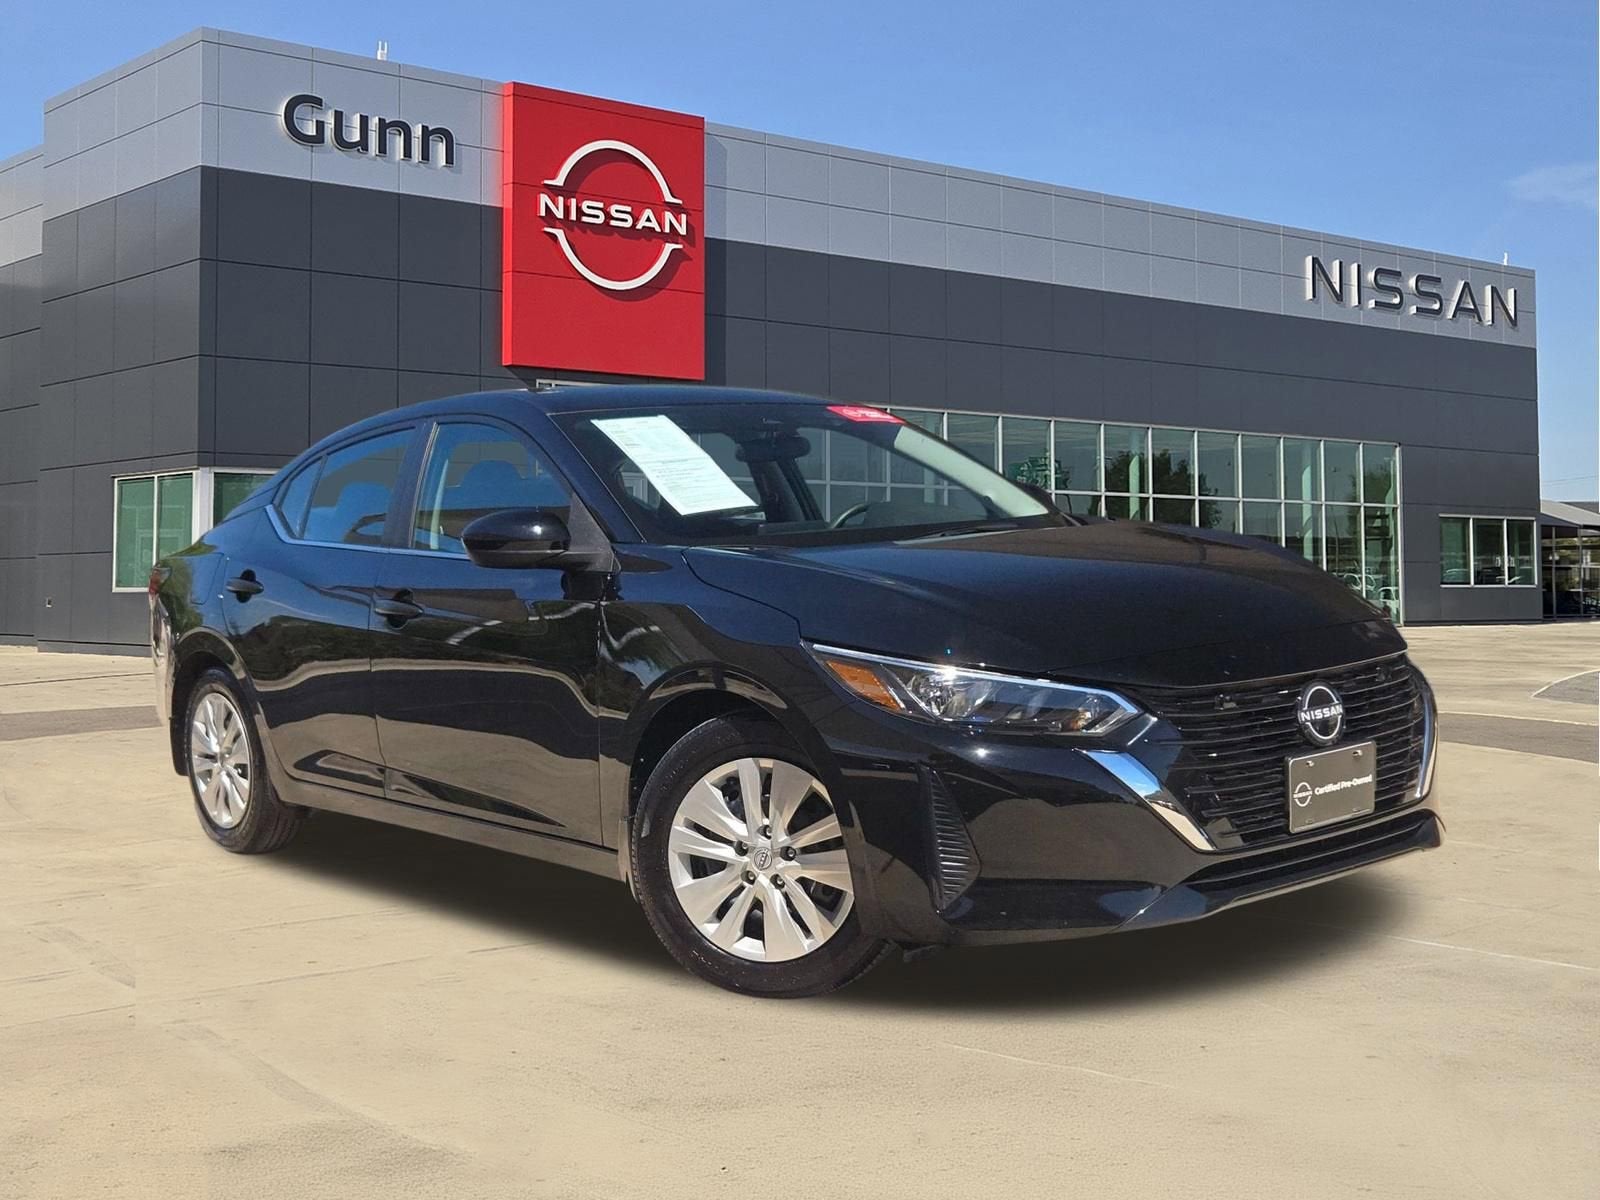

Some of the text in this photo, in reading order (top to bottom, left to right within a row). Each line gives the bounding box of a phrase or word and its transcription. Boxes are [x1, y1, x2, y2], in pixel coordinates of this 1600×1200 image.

[282, 94, 455, 167] Gunn
[538, 193, 687, 235] NISSAN
[1305, 255, 1518, 327] NISSAN
[1300, 704, 1343, 721] NISSAN
[1315, 774, 1373, 795] Certified Pre-Owned
